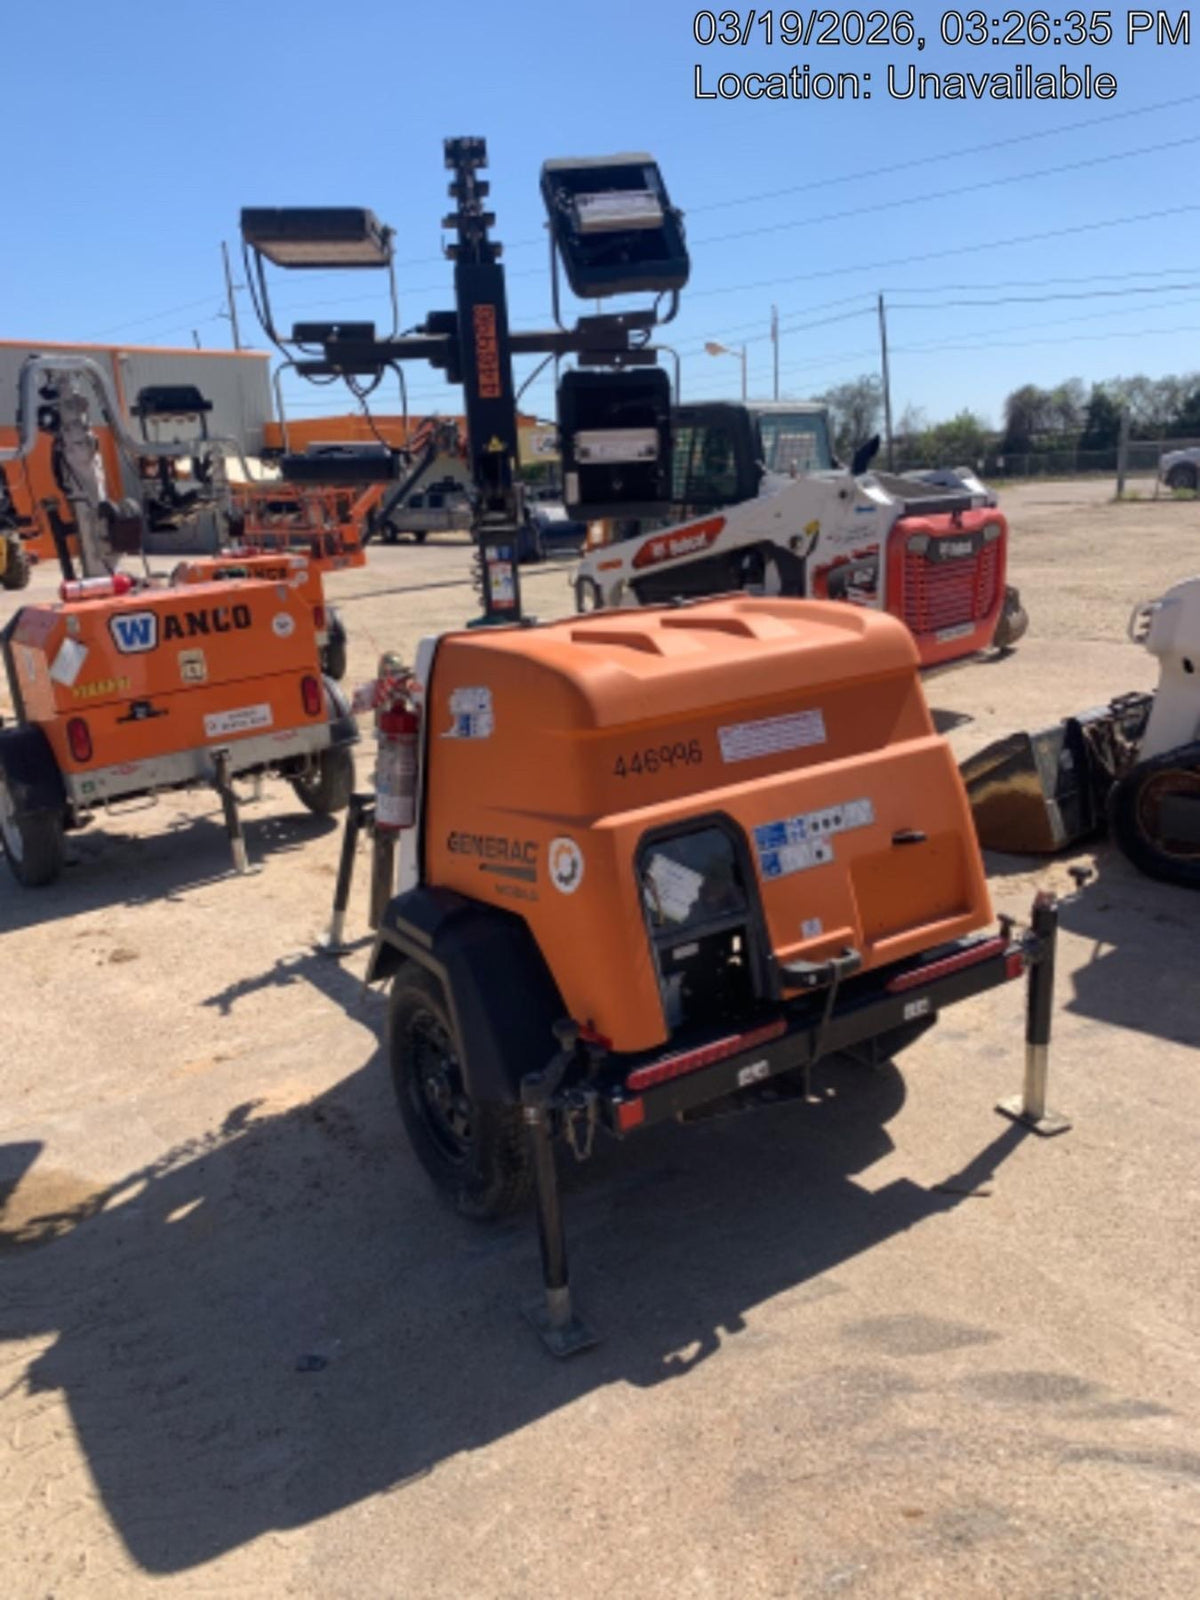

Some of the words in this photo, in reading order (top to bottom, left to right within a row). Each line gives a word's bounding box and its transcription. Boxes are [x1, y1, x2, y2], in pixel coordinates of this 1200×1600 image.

[110, 603, 252, 651] WANCO
[613, 739, 703, 778] 446996
[447, 831, 538, 865] GENERAC
